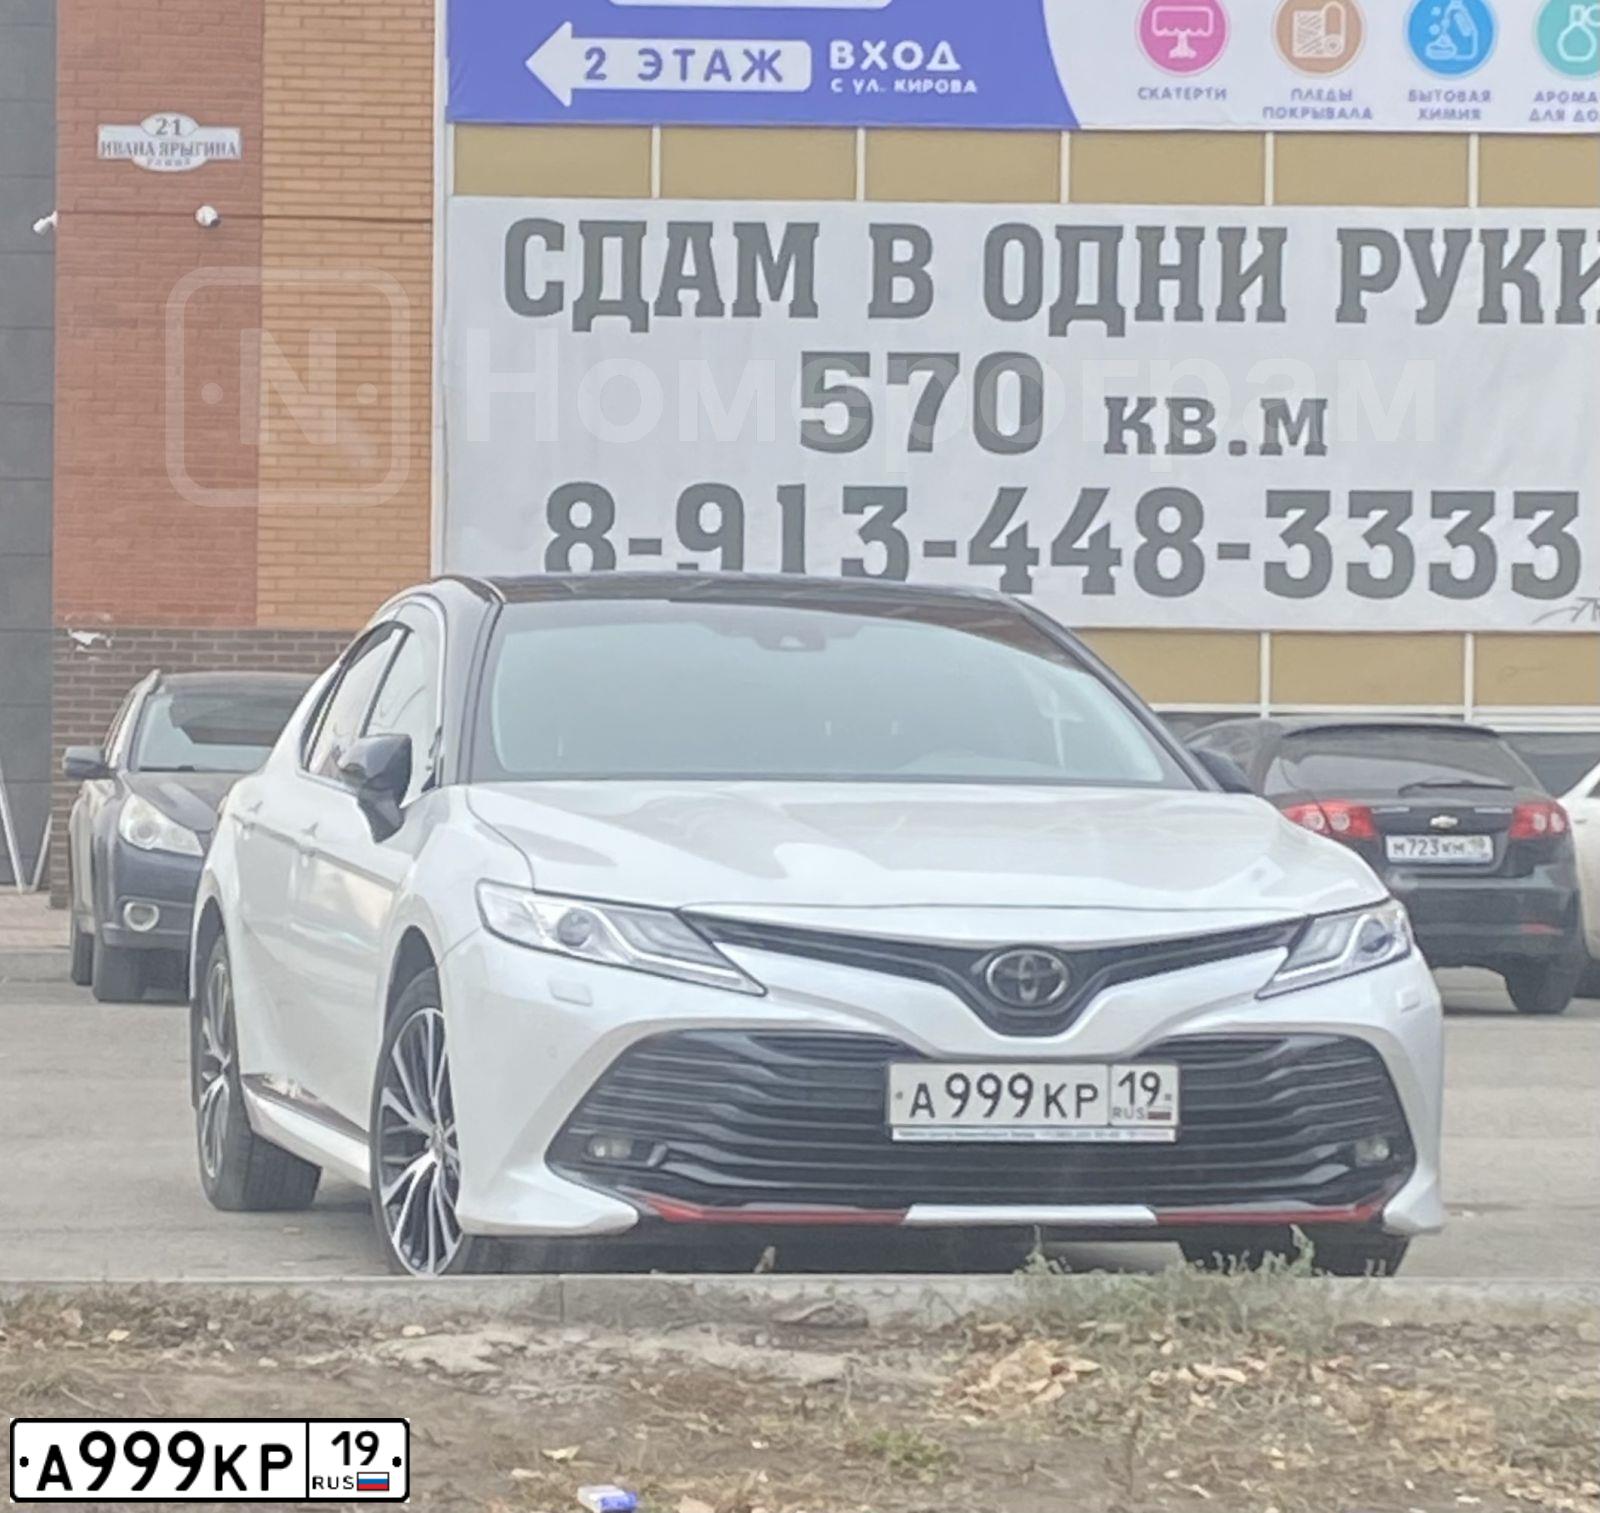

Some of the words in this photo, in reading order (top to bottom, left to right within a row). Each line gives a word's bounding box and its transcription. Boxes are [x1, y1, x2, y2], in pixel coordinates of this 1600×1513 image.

[829, 39, 961, 71] ВХОД
[584, 47, 607, 81] 2
[637, 48, 783, 83] ЭТАЖ
[893, 78, 977, 94] КИРОВА
[1137, 87, 1227, 101] СКАТЕРТИ
[1290, 88, 1353, 102] ПЛЕДЫ
[1408, 89, 1491, 103] БЫТОВАЯ
[1262, 105, 1374, 120] ПОКРЫВАЛА
[1417, 108, 1481, 121] ХИМИЯ
[1528, 109, 1566, 122] ДЛЯ
[155, 117, 182, 136] 21
[101, 141, 155, 157] ИВАНА
[158, 141, 237, 158] ЯРЫГИНА
[504, 217, 820, 333] СДАМ
[867, 223, 934, 319] В
[983, 222, 1288, 337] ОДНИ
[800, 351, 1044, 455] 570
[1103, 396, 1328, 456] кв.м
[544, 481, 1582, 599] 8-913-448-3333
[909, 1072, 1099, 1118] А999КР
[1118, 1071, 1161, 1106] 19
[1112, 1107, 1145, 1120] RUS
